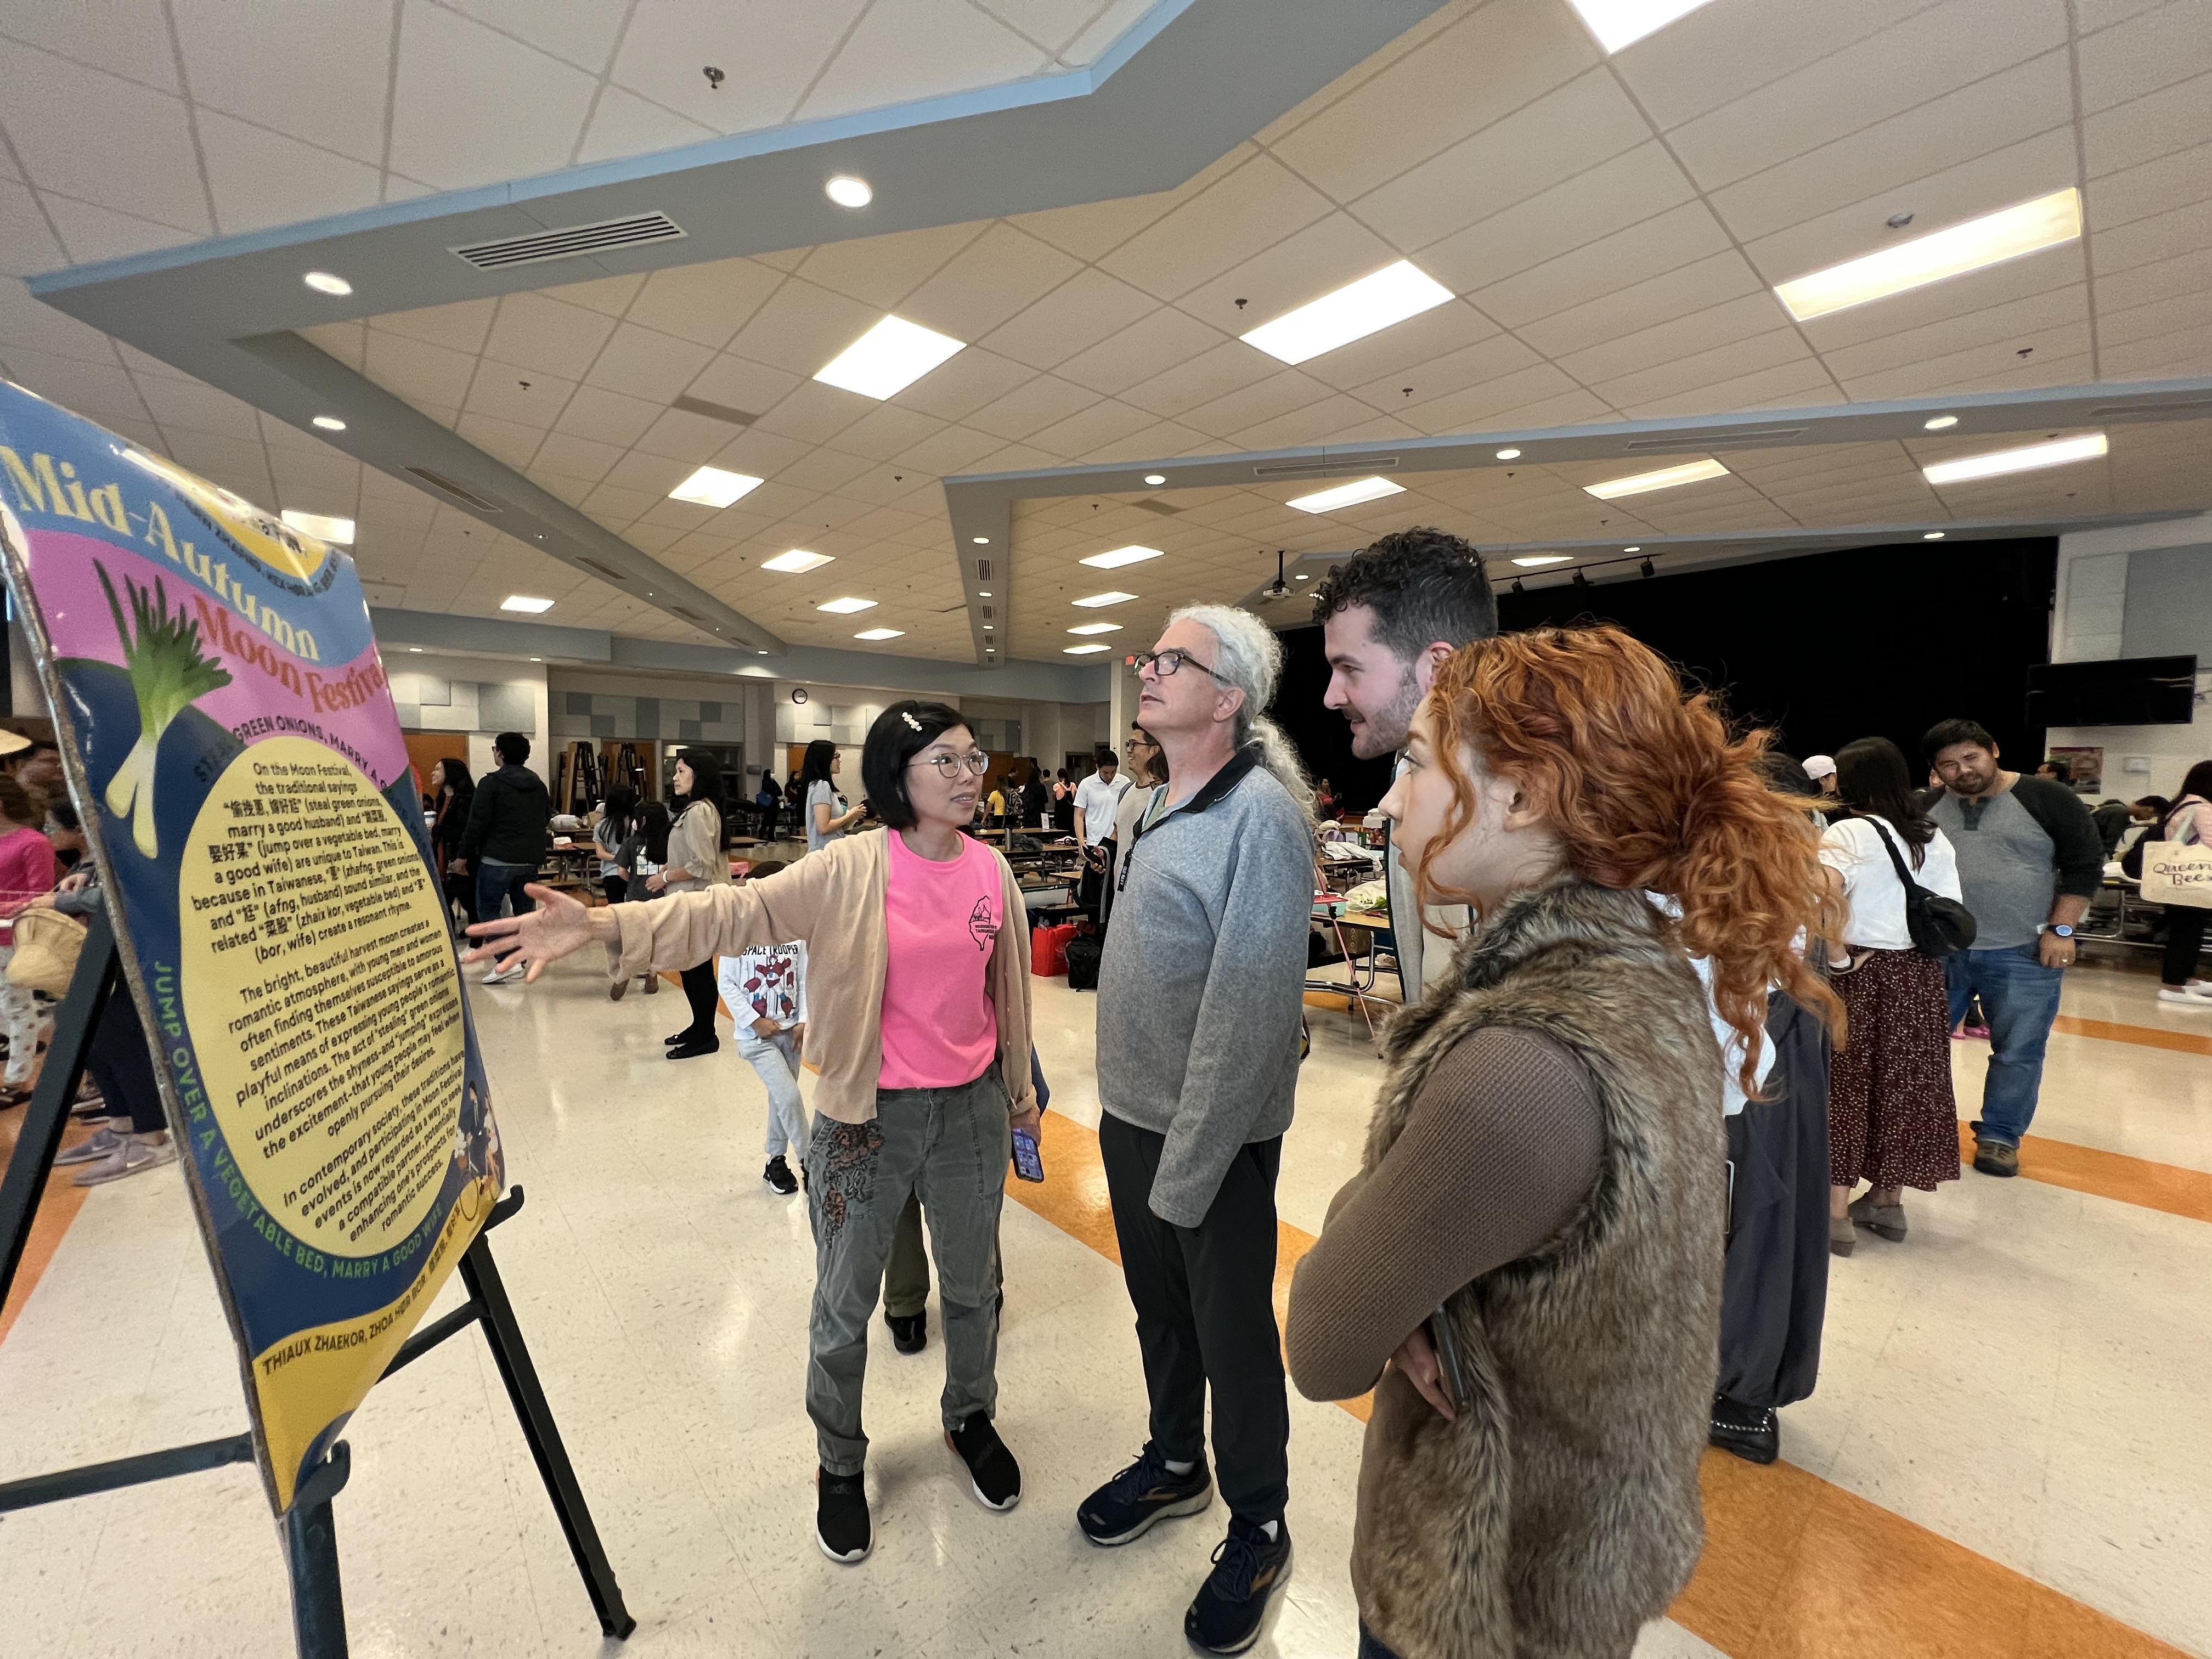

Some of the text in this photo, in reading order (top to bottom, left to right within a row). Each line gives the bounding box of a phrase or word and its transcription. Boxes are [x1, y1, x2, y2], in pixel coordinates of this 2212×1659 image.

[0, 445, 320, 661] Mid-Autumn
[194, 594, 303, 698] Moon
[233, 715, 274, 743] GREEN
[276, 715, 328, 743] ONIONS,
[329, 733, 368, 770] MARRY
[253, 763, 269, 775] On
[270, 764, 288, 775] the
[290, 764, 316, 775] Moon
[228, 825, 265, 838] marry
[268, 823, 275, 833] a
[277, 817, 303, 836] good
[346, 812, 361, 825] and
[255, 780, 358, 795] the traditional sayings
[332, 800, 356, 812] green
[214, 872, 223, 884] a
[226, 861, 261, 885] good
[263, 856, 293, 874] wife)
[295, 857, 311, 869] are
[313, 850, 342, 866] unique
[342, 849, 352, 860] to
[257, 840, 291, 858] (jump
[292, 838, 313, 850] over
[315, 837, 321, 847] a
[322, 829, 363, 847] vegetable
[191, 888, 251, 911] because
[252, 882, 266, 898] in
[267, 873, 326, 894] Taiwanese,
[376, 858, 396, 873] green
[210, 910, 235, 930] and
[300, 884, 343, 906] husband)
[343, 878, 368, 895] sound
[396, 868, 409, 881] and
[210, 926, 257, 954] related
[345, 889, 383, 913] vegetable
[383, 885, 400, 900] bed)
[401, 882, 414, 895] and
[239, 921, 425, 1004] The bright, beautiful harvest moon creates
[255, 944, 286, 964] (bor,
[286, 929, 317, 952] wife)
[318, 923, 346, 941] create
[348, 921, 353, 930] a
[353, 908, 388, 928] resonant
[228, 998, 283, 1034] romantic
[284, 973, 349, 1008] atmosphere,
[348, 961, 366, 978] with
[366, 953, 390, 973] young
[390, 945, 405, 959] men
[406, 937, 419, 952] and
[240, 945, 443, 1052] often finding themselves susceptible to amorous
[250, 1029, 315, 1071] sentiments.
[315, 1012, 347, 1034] These
[347, 989, 387, 1018] Taiwanese
[387, 976, 414, 996] sayings
[414, 966, 432, 981] serve
[236, 1066, 282, 1108] playful
[284, 1048, 318, 1076] means
[319, 1036, 329, 1054] of
[331, 1013, 377, 1047] expressing
[377, 1000, 400, 1023] young
[264, 1000, 428, 1111] inclinations. The act of green
[155, 961, 182, 1038] JUMP
[172, 1046, 207, 1123] OVER
[199, 1128, 217, 1150] A
[215, 1148, 292, 1256] VEGETABLE
[295, 1245, 328, 1278] BED,
[332, 1259, 377, 1278] MARRY
[382, 1256, 390, 1272] A
[393, 1233, 421, 1266] GOOD
[255, 1086, 328, 1141] underscores
[329, 1074, 345, 1091] the
[263, 1137, 286, 1159] the
[371, 1060, 393, 1086] young
[394, 1042, 417, 1067] people
[418, 1033, 431, 1047] may
[328, 1105, 359, 1137] openly
[360, 1079, 394, 1115] pursuing
[393, 1064, 410, 1084] their
[284, 1190, 297, 1207] In
[300, 1129, 371, 1195] contemporary
[373, 1104, 402, 1135] society,
[402, 1087, 420, 1108] these
[302, 1169, 350, 1216] evolved,
[351, 1151, 368, 1175] and
[369, 1110, 416, 1163] participating
[415, 1102, 423, 1115] in
[422, 1087, 440, 1107] Moon
[315, 1190, 353, 1229] events
[352, 1180, 362, 1194] is
[363, 1163, 380, 1186] now
[382, 1127, 414, 1168] regarded
[415, 1122, 422, 1135] as
[424, 1117, 427, 1126] a
[428, 1104, 440, 1121] way
[339, 1219, 345, 1231] a
[347, 1169, 396, 1222] compatible
[396, 1141, 425, 1176] partner,
[350, 1189, 396, 1242] enhancing
[415, 1135, 447, 1176] prospects
[382, 1159, 443, 1231] romantic success.
[262, 1338, 311, 1375] THIAUX
